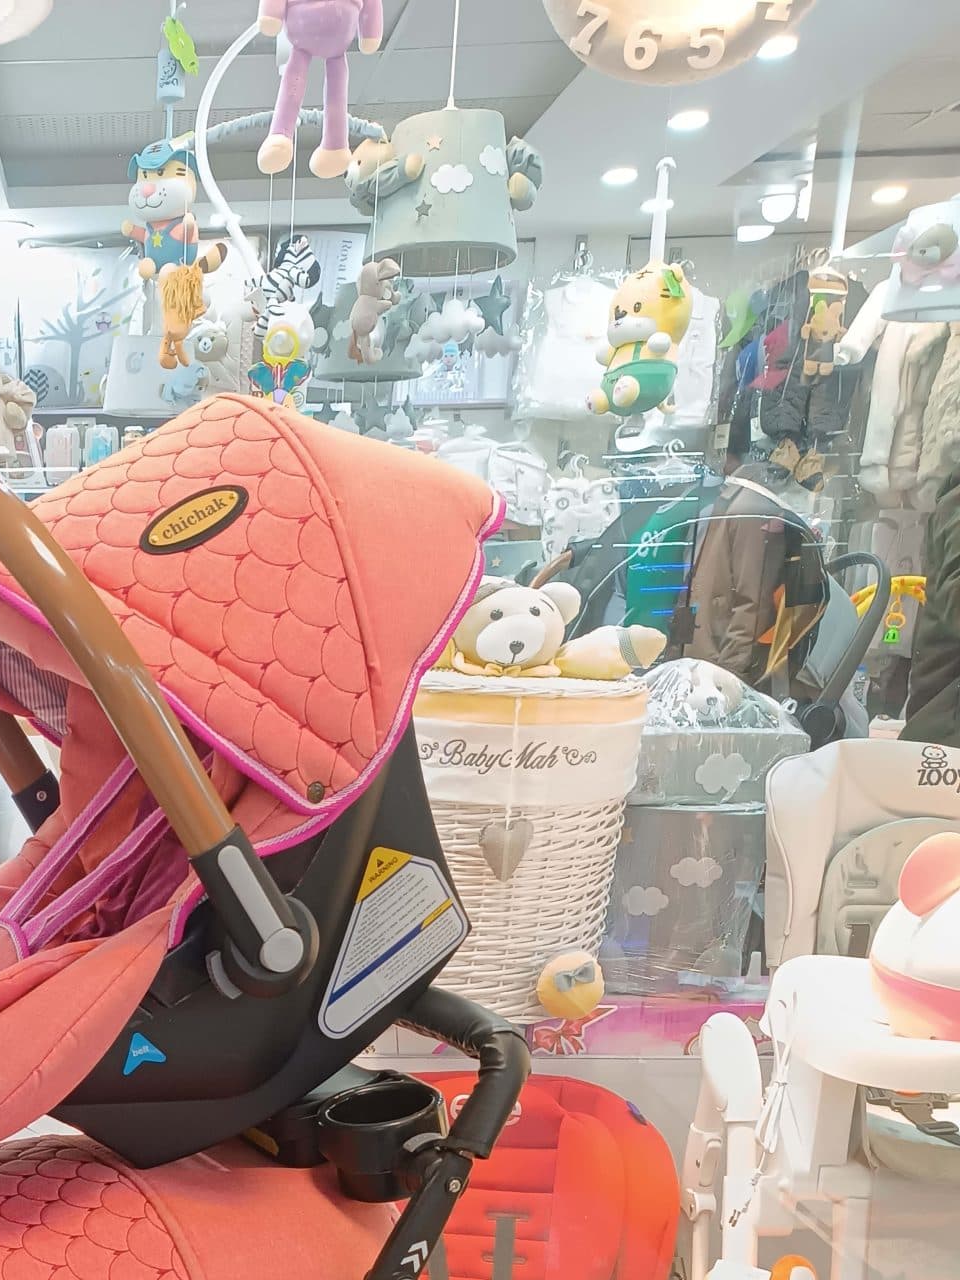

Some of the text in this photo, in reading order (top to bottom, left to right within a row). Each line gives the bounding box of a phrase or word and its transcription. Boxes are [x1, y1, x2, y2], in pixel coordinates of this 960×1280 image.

[623, 28, 662, 70] 6
[687, 27, 725, 69] 5
[162, 497, 228, 540] chichak
[917, 768, 960, 794] zoo
